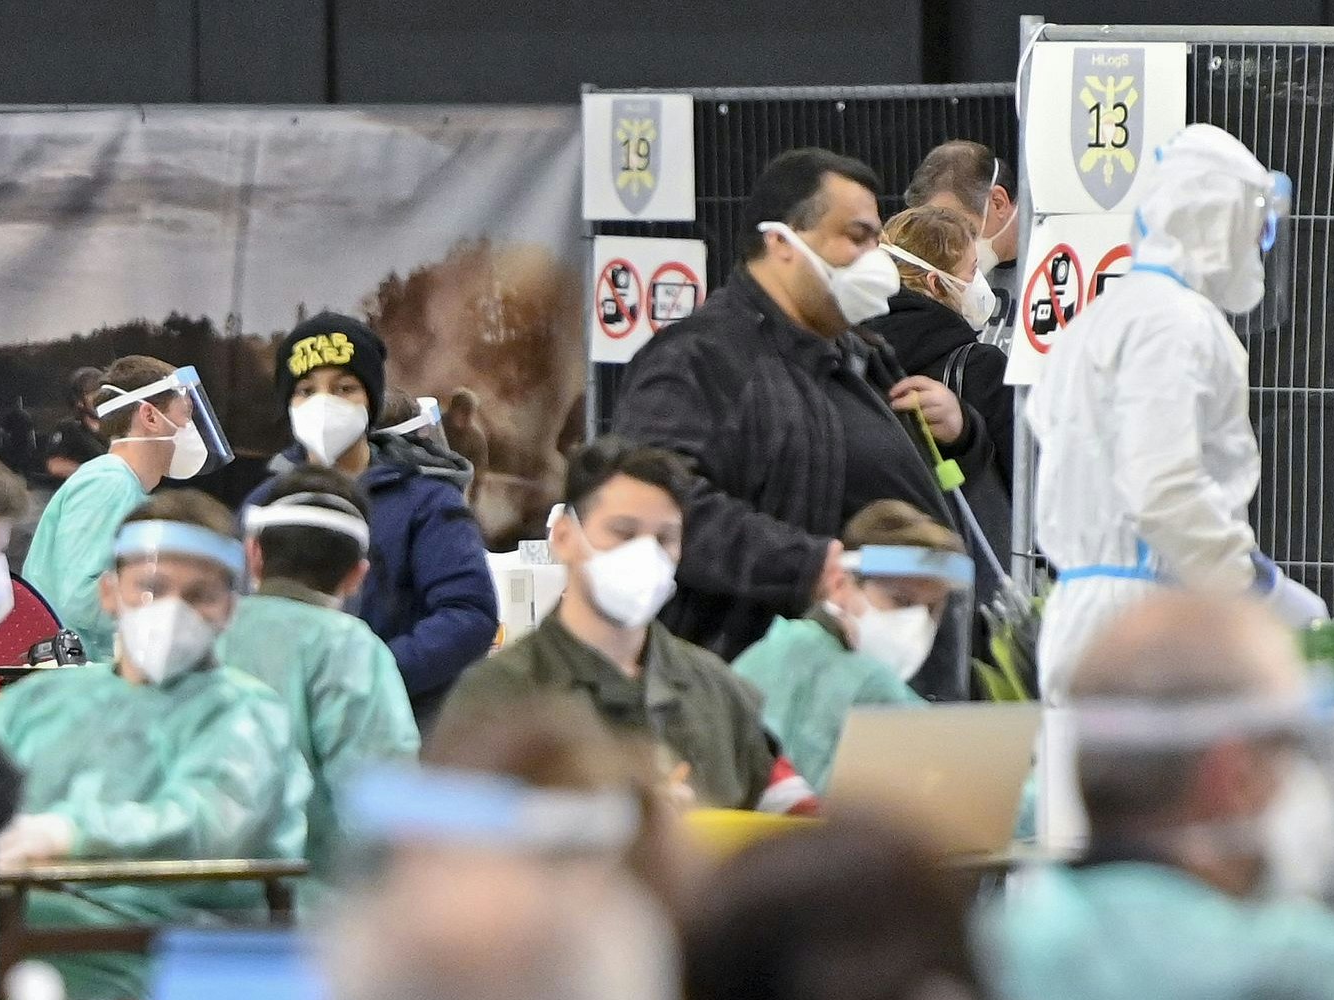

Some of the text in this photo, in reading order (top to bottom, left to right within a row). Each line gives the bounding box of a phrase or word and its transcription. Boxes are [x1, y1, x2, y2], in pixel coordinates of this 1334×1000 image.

[1088, 102, 1129, 148] 13
[622, 138, 650, 171] 19
[287, 345, 353, 376] WARS
[292, 332, 352, 357] STAR
